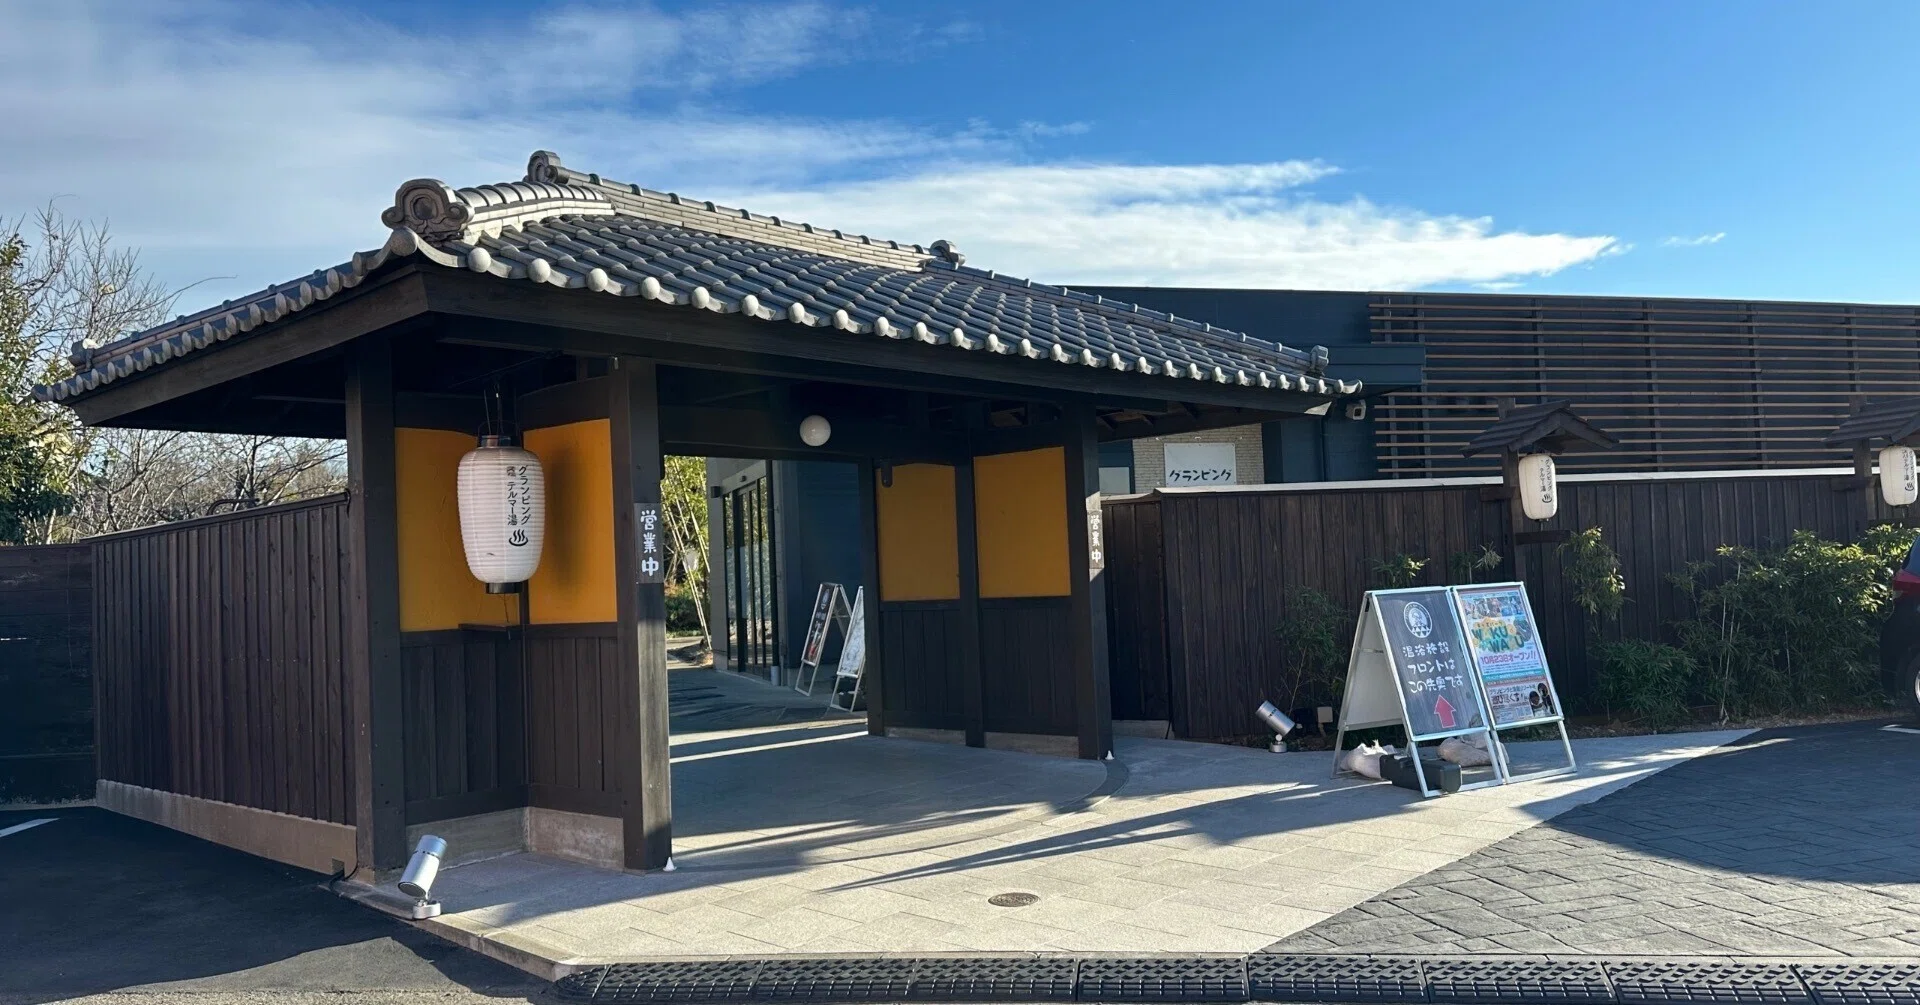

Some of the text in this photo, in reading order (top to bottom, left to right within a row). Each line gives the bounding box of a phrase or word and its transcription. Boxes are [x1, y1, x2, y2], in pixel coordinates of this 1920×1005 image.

[1169, 469, 1233, 482] グランピング
[519, 465, 531, 525] グランピング
[640, 509, 659, 577] 営業中
[1090, 514, 1101, 563] 営業中
[1402, 641, 1450, 658] 温浴施設
[1407, 658, 1455, 675] フロントは
[1408, 674, 1463, 693] この先奥です
